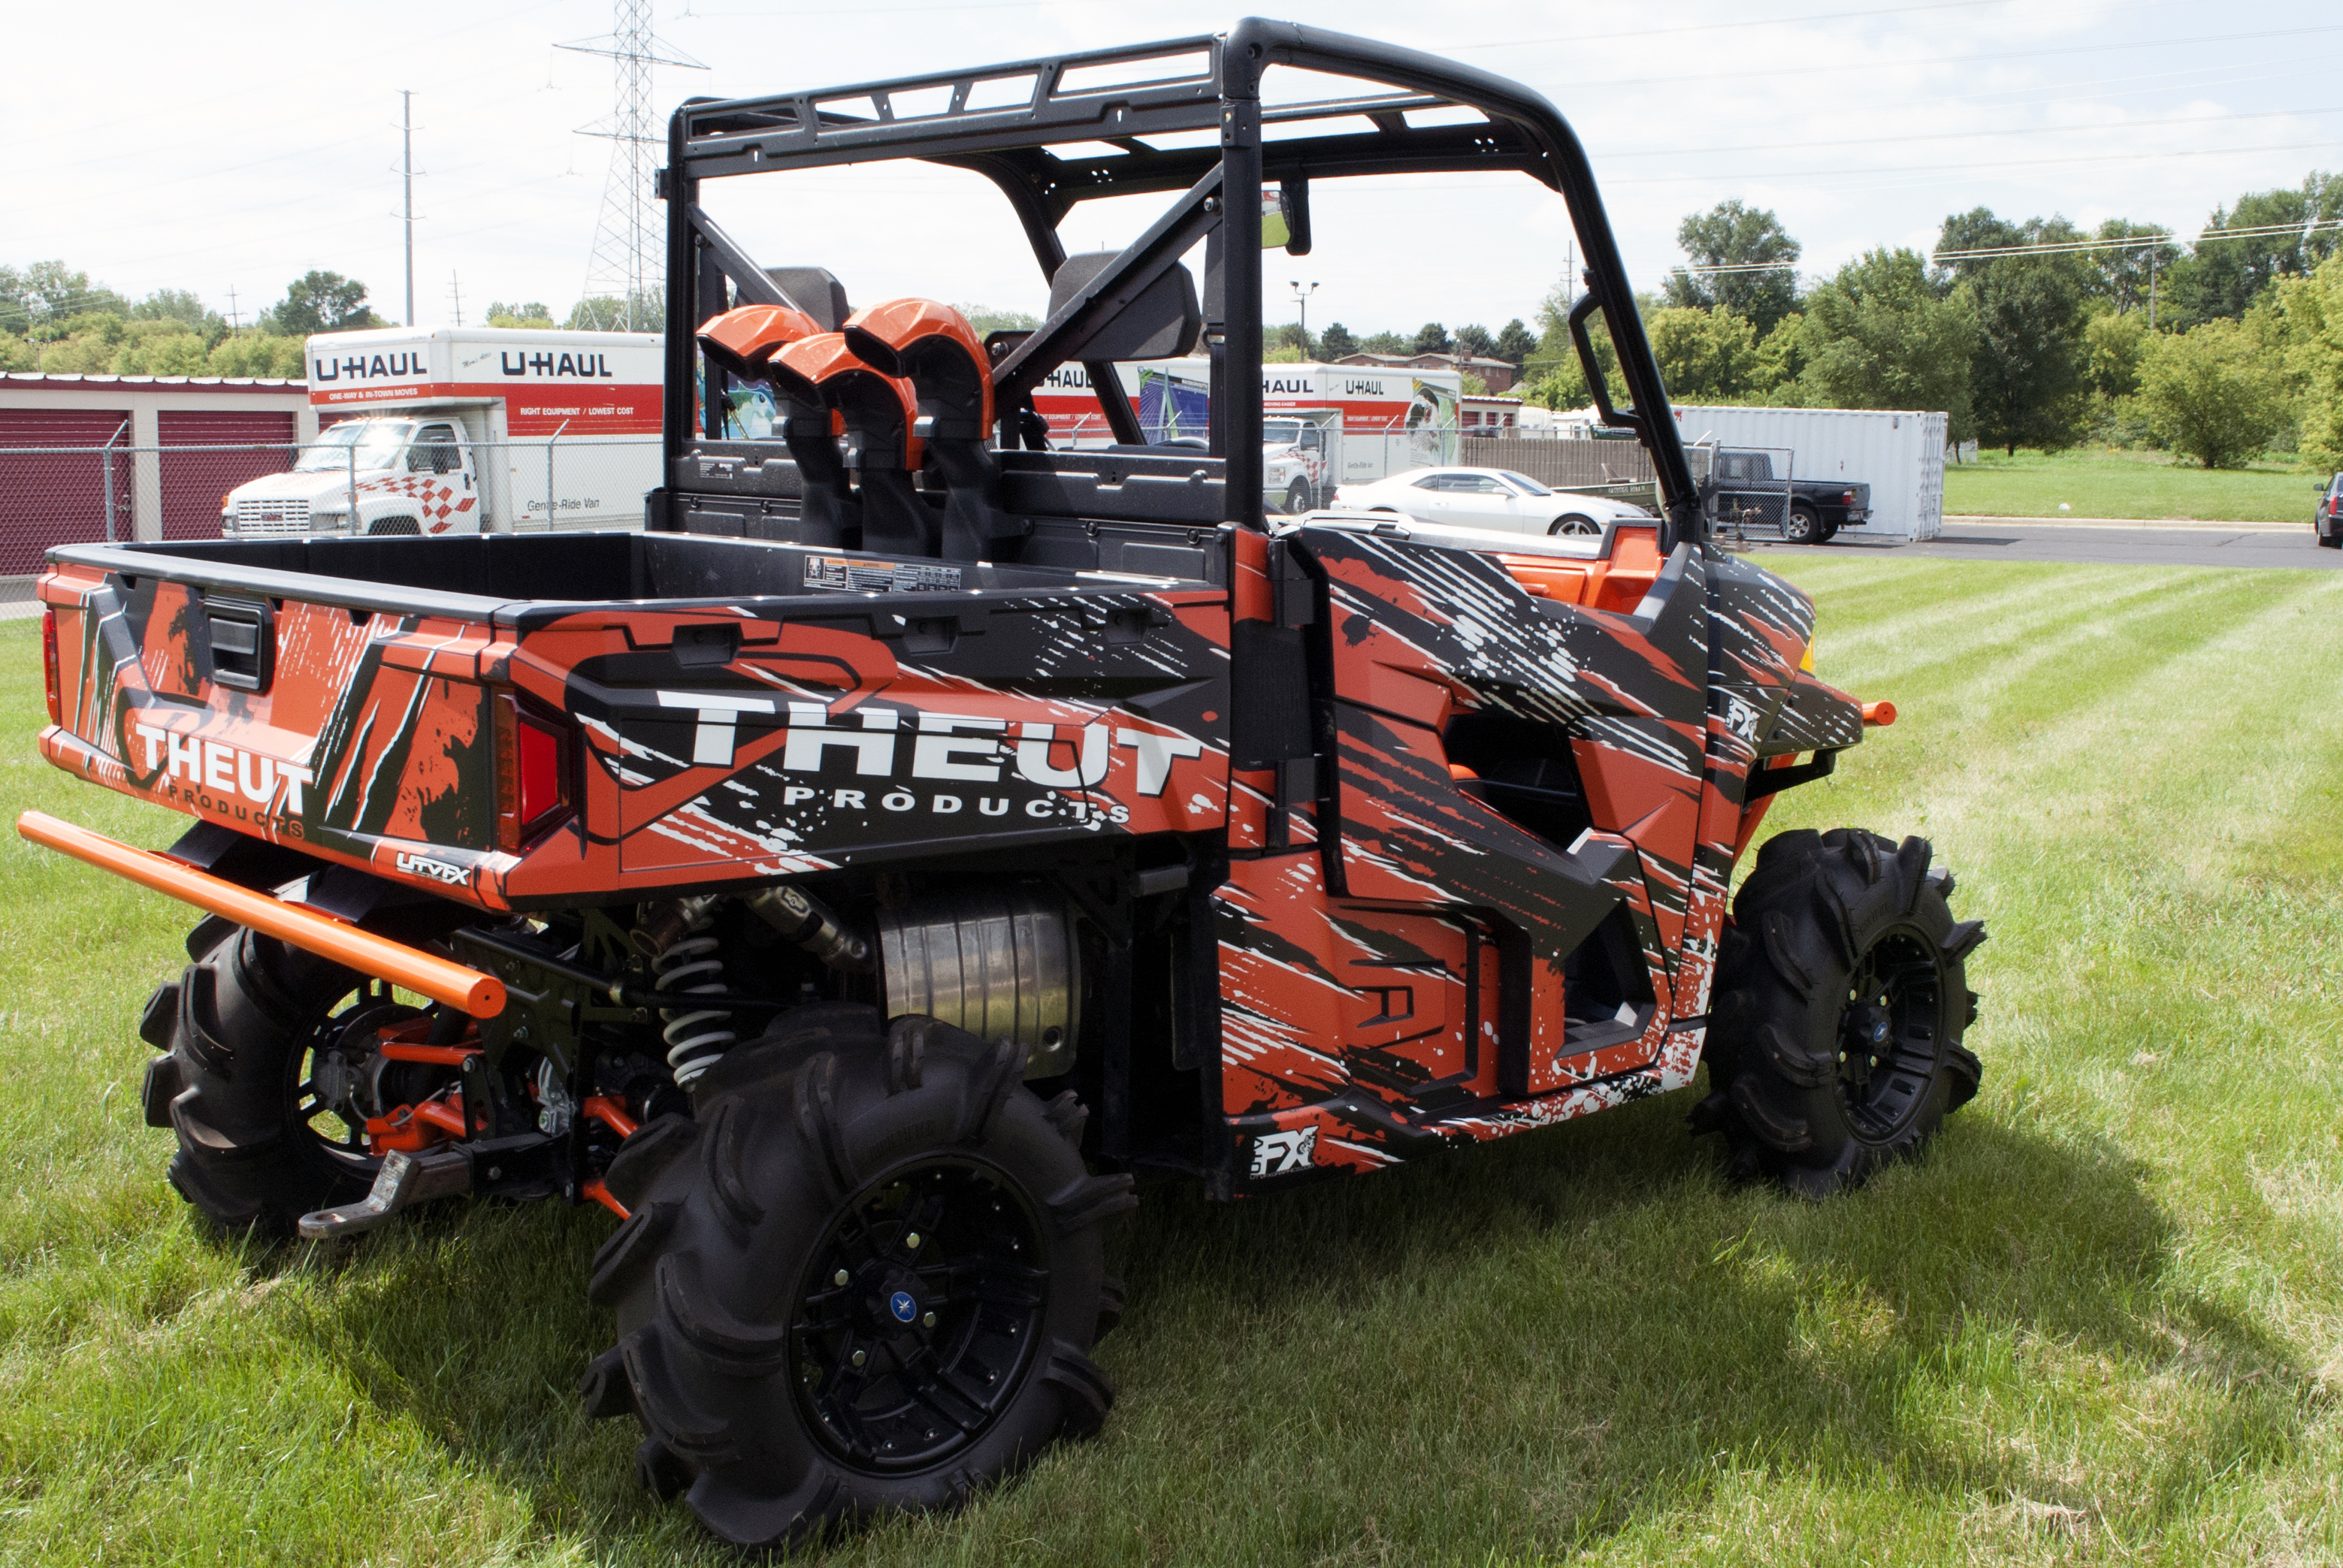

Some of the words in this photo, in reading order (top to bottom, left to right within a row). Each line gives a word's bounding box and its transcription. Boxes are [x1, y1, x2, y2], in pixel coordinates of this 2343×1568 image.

[316, 352, 428, 382] U-HAUL
[501, 352, 613, 377] U-HAUL
[329, 392, 358, 400] ONE-WAY
[358, 391, 364, 399] &
[365, 389, 394, 398] IN-TOWN
[395, 388, 419, 397] MOVES
[1346, 379, 1384, 395] U-HAUL
[520, 407, 541, 415] RIGHT
[543, 407, 581, 415] EQUIPMENT
[582, 407, 587, 415] /
[588, 407, 615, 415] LOWEST
[616, 407, 634, 415] COST
[584, 497, 600, 509] Van
[657, 690, 1202, 797] THEUT
[136, 723, 313, 816] THEUT
[169, 784, 304, 839] PRODUCTS
[783, 786, 1129, 824] PRODUCTS
